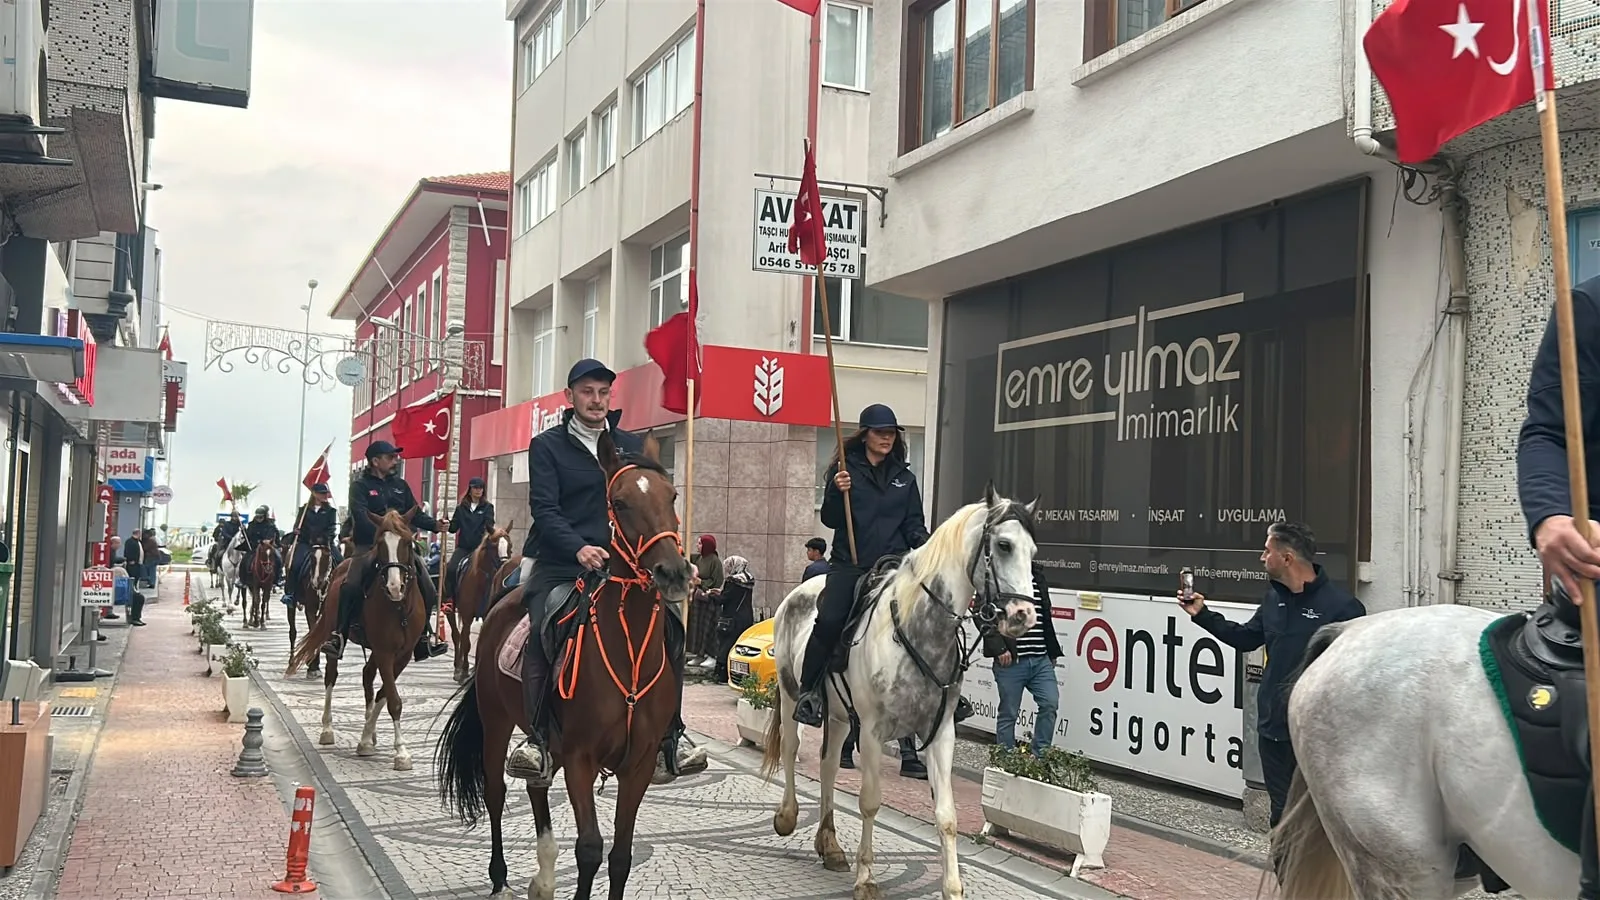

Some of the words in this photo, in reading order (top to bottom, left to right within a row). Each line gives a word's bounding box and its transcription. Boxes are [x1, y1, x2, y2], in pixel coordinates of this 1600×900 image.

[760, 196, 858, 230] AVAT
[759, 226, 778, 238] TAŞCI
[768, 241, 787, 254] Arif
[826, 246, 850, 261] AŞCI
[760, 256, 791, 268] 0546
[822, 262, 837, 272] 75
[840, 263, 856, 274] 78
[1005, 357, 1093, 409] emre
[1125, 394, 1240, 441] mimarlık
[110, 448, 137, 459] ada
[106, 462, 142, 476] optik
[1045, 509, 1076, 521] MEKAN
[1078, 509, 1119, 522] TASARIMI
[1148, 506, 1185, 525] İNŞAAT
[1218, 508, 1286, 522] UYGULAMA
[82, 571, 113, 582] VESTEL
[83, 590, 110, 598] Göktaş
[1089, 701, 1243, 770] sigorta
